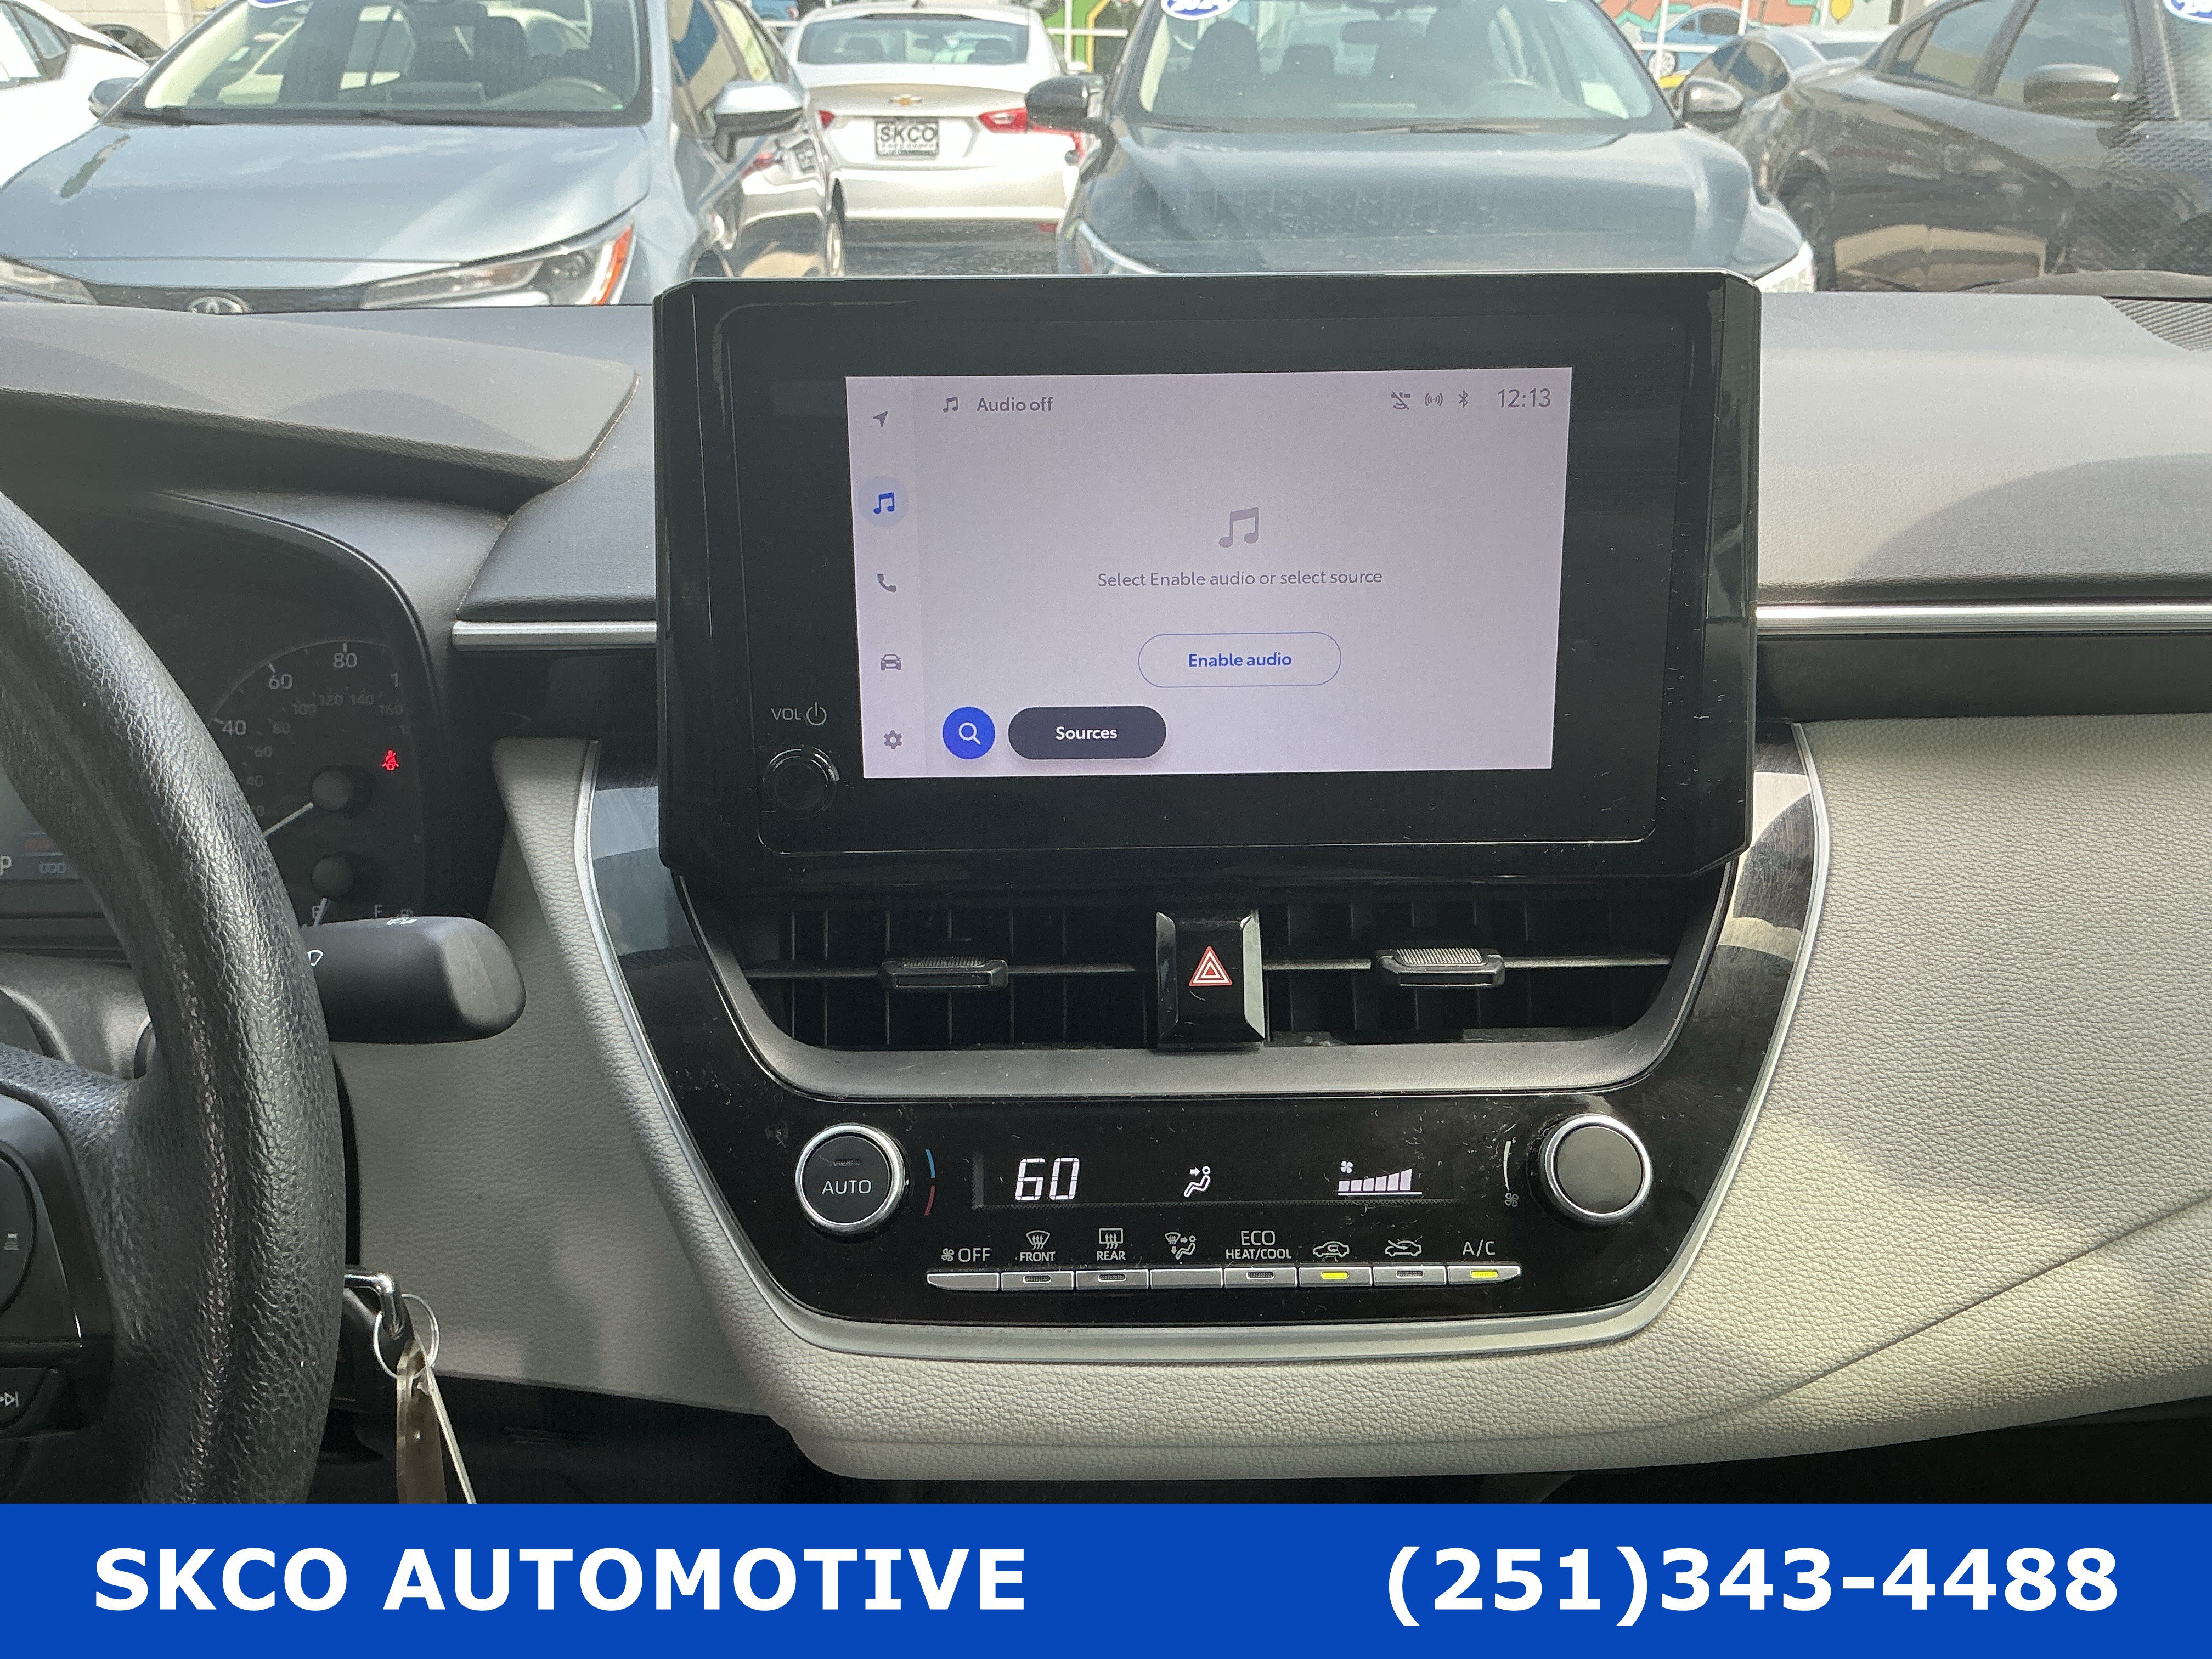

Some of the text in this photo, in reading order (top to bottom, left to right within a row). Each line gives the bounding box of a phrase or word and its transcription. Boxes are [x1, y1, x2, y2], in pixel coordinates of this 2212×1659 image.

[879, 126, 935, 142] SKCO
[976, 396, 1054, 413] Audio off
[1497, 388, 1551, 408] 12:13
[1097, 569, 1383, 587] Select Enable audio or select source
[332, 652, 358, 669] 80
[1188, 651, 1293, 668] Enable audio
[267, 673, 294, 691] 60
[770, 707, 802, 722] VOL
[221, 719, 247, 736] 40
[1055, 725, 1118, 741] Sources
[0, 855, 12, 877] P
[821, 1178, 872, 1195] AUTO
[1014, 1156, 1080, 1201] 60
[1240, 1229, 1276, 1247] ECO
[957, 1246, 992, 1263] OFF
[1019, 1250, 1056, 1262] FRONT
[1096, 1250, 1126, 1261] REAR
[1225, 1248, 1292, 1261] HEAT/COOL
[1462, 1239, 1496, 1257] A/C
